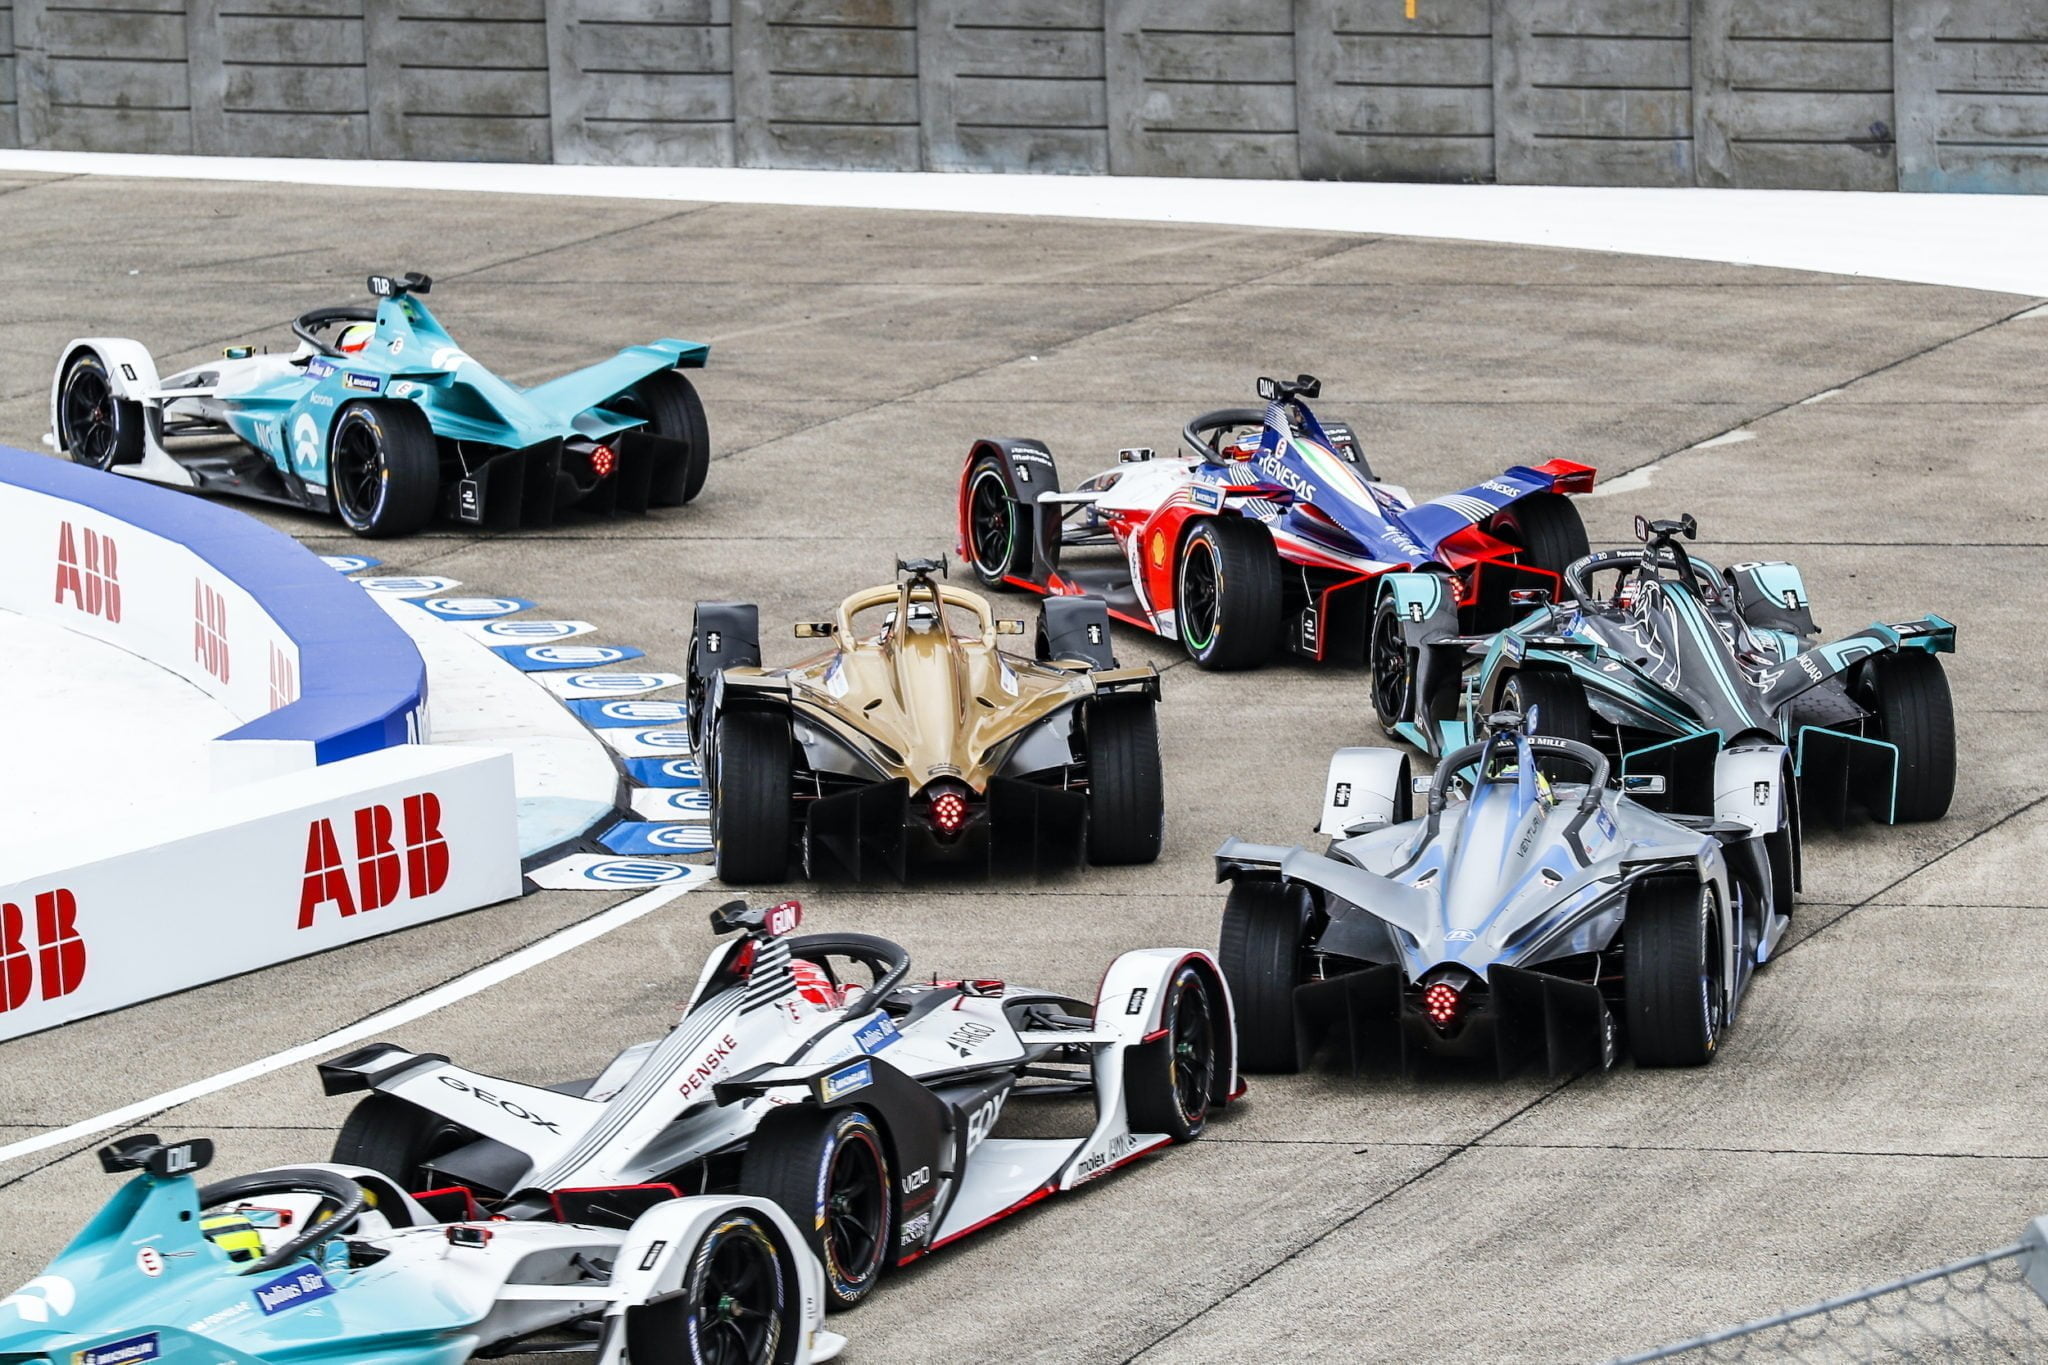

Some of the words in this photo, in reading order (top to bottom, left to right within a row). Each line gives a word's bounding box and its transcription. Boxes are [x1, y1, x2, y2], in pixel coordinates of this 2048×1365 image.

[372, 277, 390, 295] TUR
[1259, 378, 1275, 399] DAM
[1259, 448, 1317, 502] RENESAS
[54, 521, 121, 624] ABB
[195, 576, 230, 685] ABB
[297, 792, 450, 930] ABB
[679, 1034, 738, 1100] PENSKE
[438, 1075, 562, 1136] GEOX
[167, 1145, 197, 1172] DIL
[257, 1283, 302, 1311] Julius
